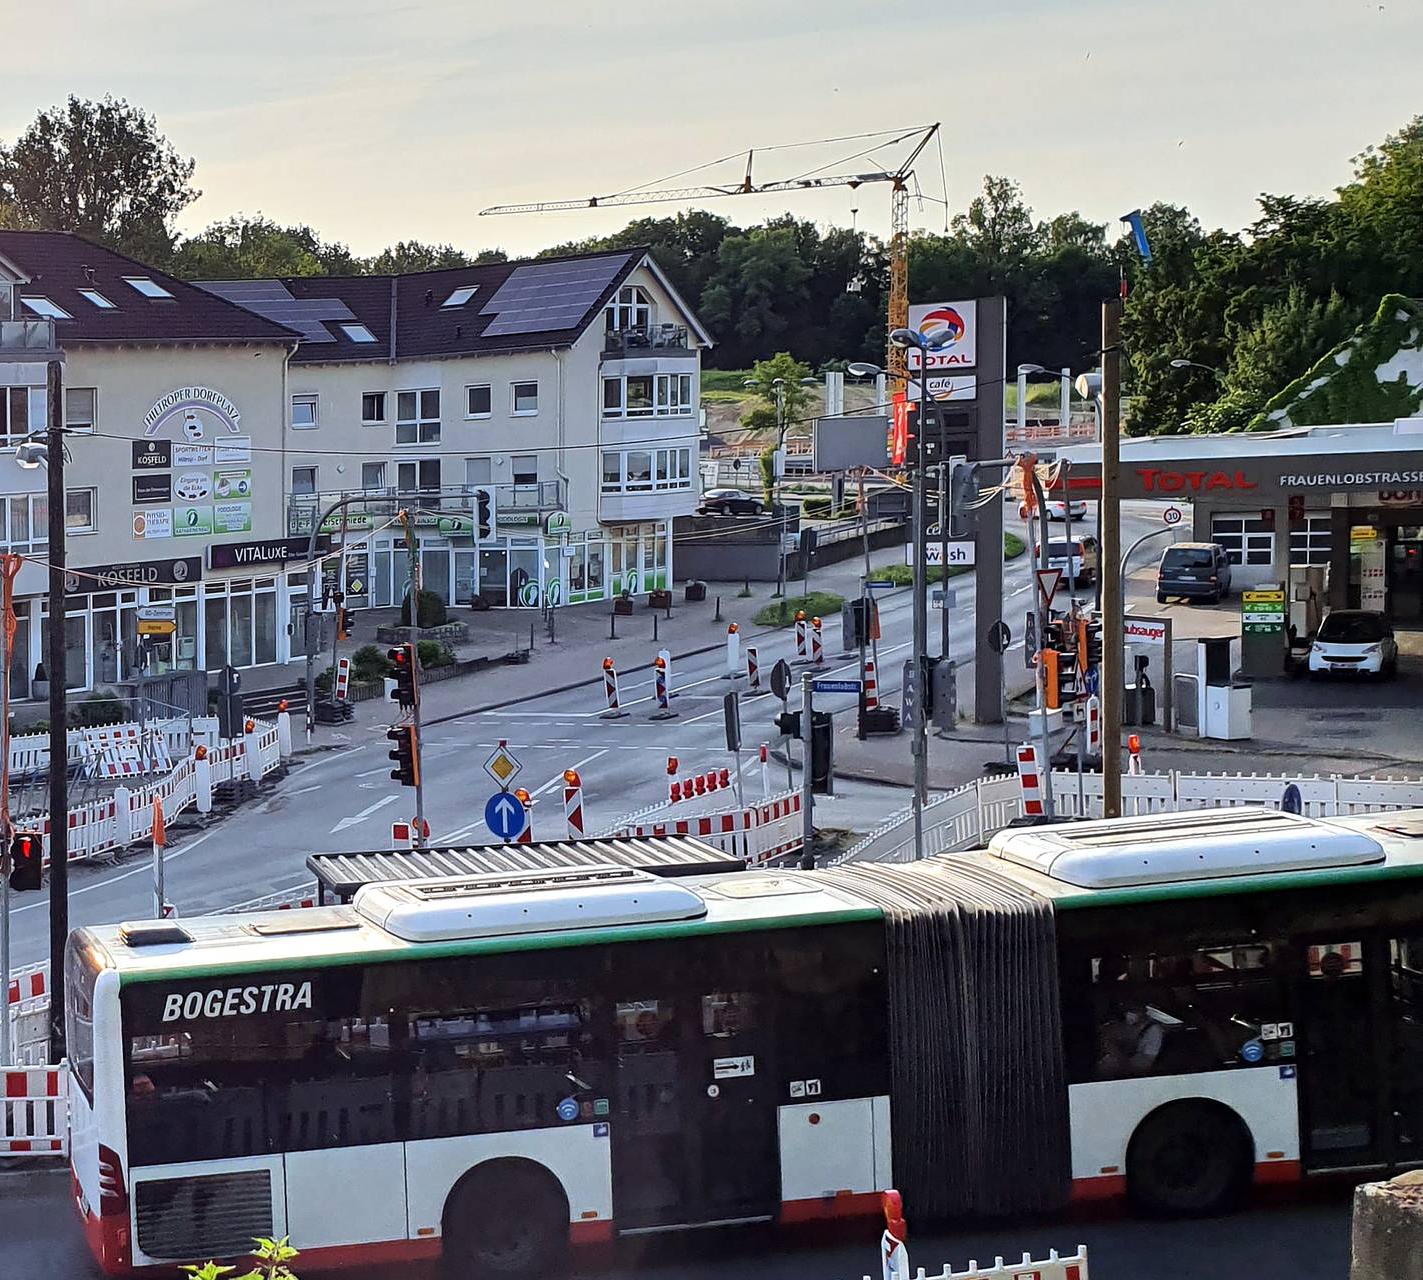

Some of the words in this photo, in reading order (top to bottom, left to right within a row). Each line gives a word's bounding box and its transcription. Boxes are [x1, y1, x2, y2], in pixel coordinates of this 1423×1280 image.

[912, 354, 972, 366] TOTAL
[929, 379, 951, 389] café
[145, 388, 191, 425] HILTROPER
[193, 388, 239, 420] DORFPLATZ
[137, 455, 167, 465] KOSFELD
[1136, 468, 1258, 492] TOTAL
[1279, 470, 1423, 487] FRAUENLOBSTRASSE
[97, 567, 158, 587] KOSFELD
[1124, 624, 1165, 640] ubsauger
[161, 981, 313, 1023] BOGESTRA
